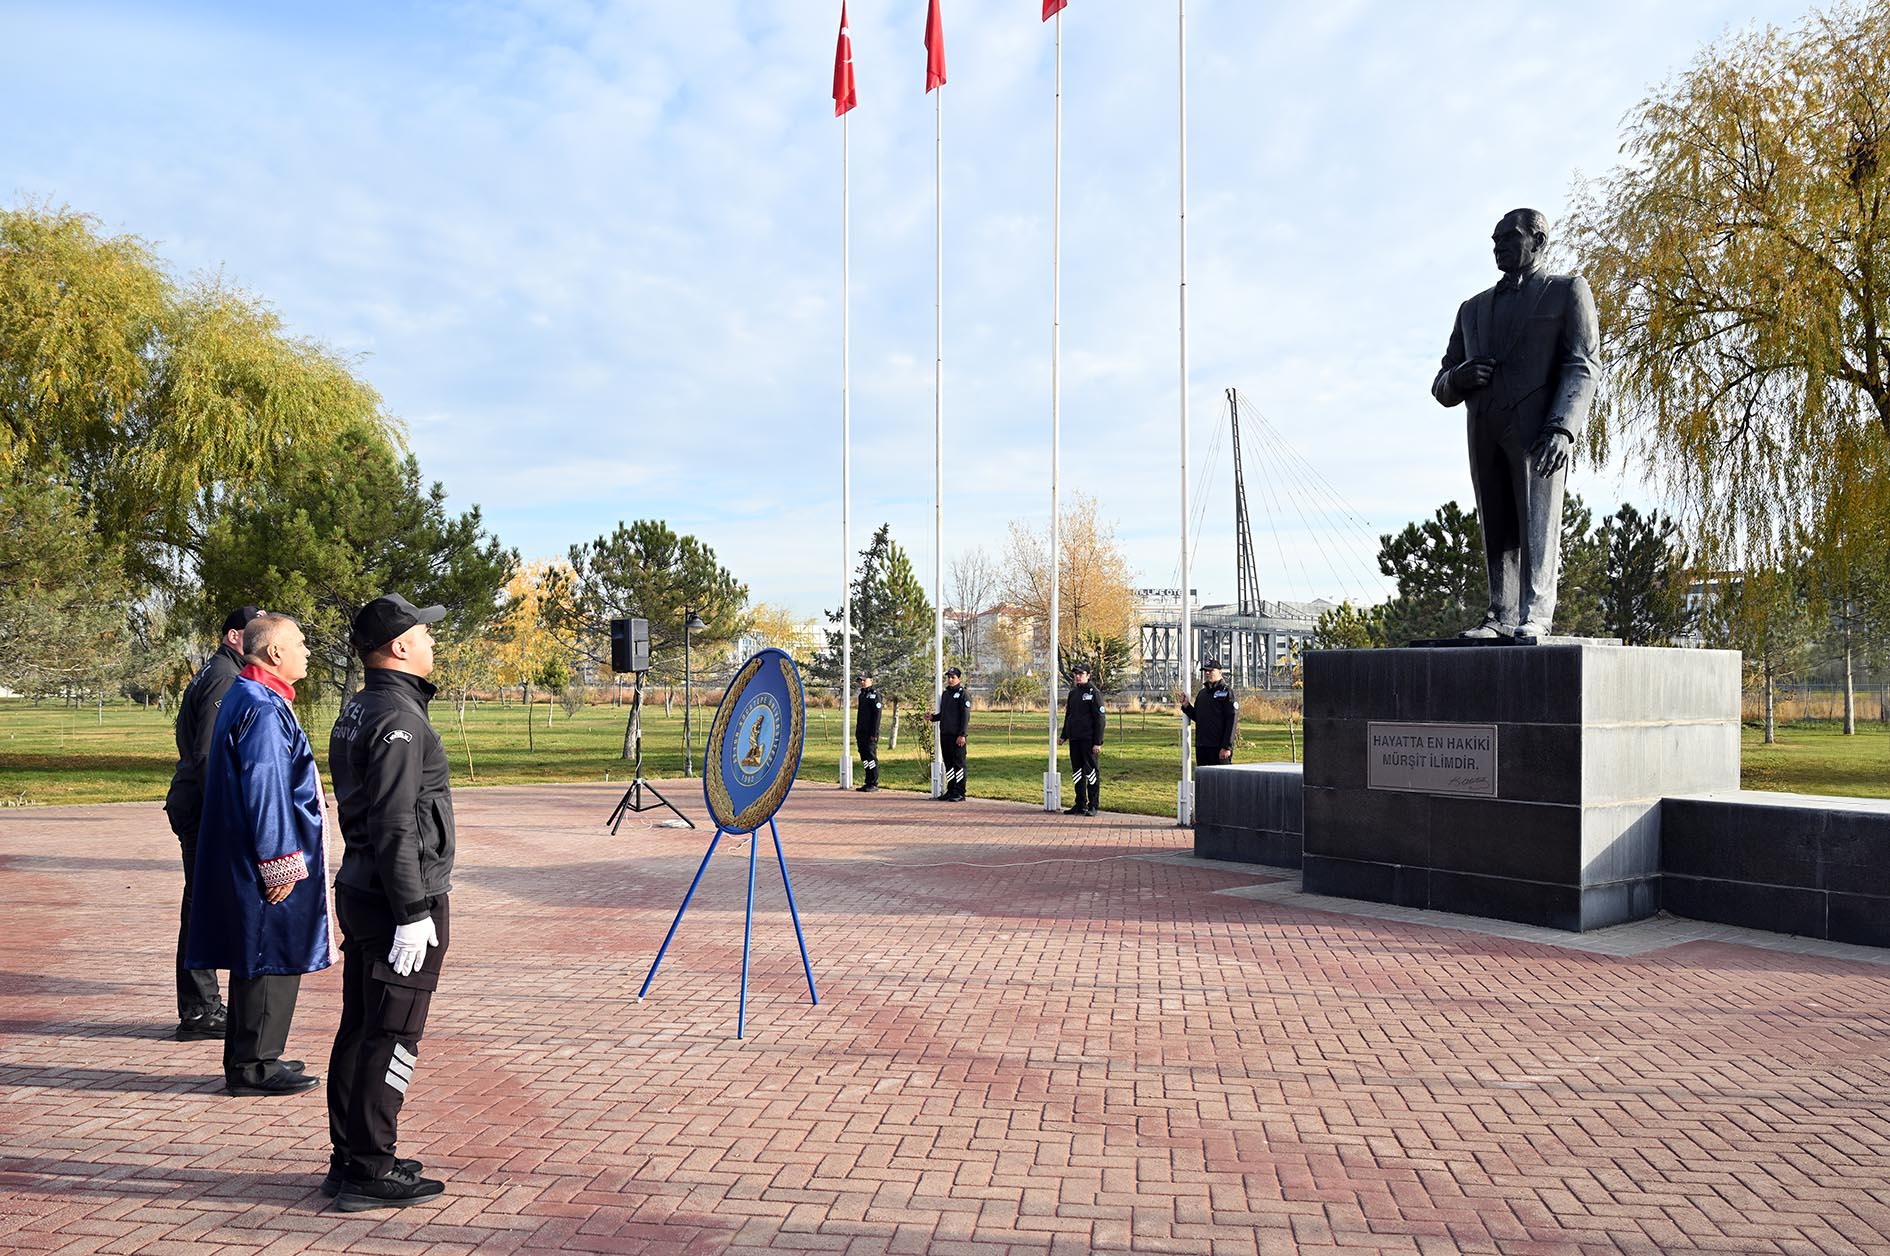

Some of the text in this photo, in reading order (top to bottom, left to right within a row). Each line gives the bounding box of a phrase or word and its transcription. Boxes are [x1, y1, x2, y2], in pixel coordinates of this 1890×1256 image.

[1373, 735, 1490, 751] HAYATTA EN HAKİKİ
[1382, 752, 1427, 770] MÜRŞİT
